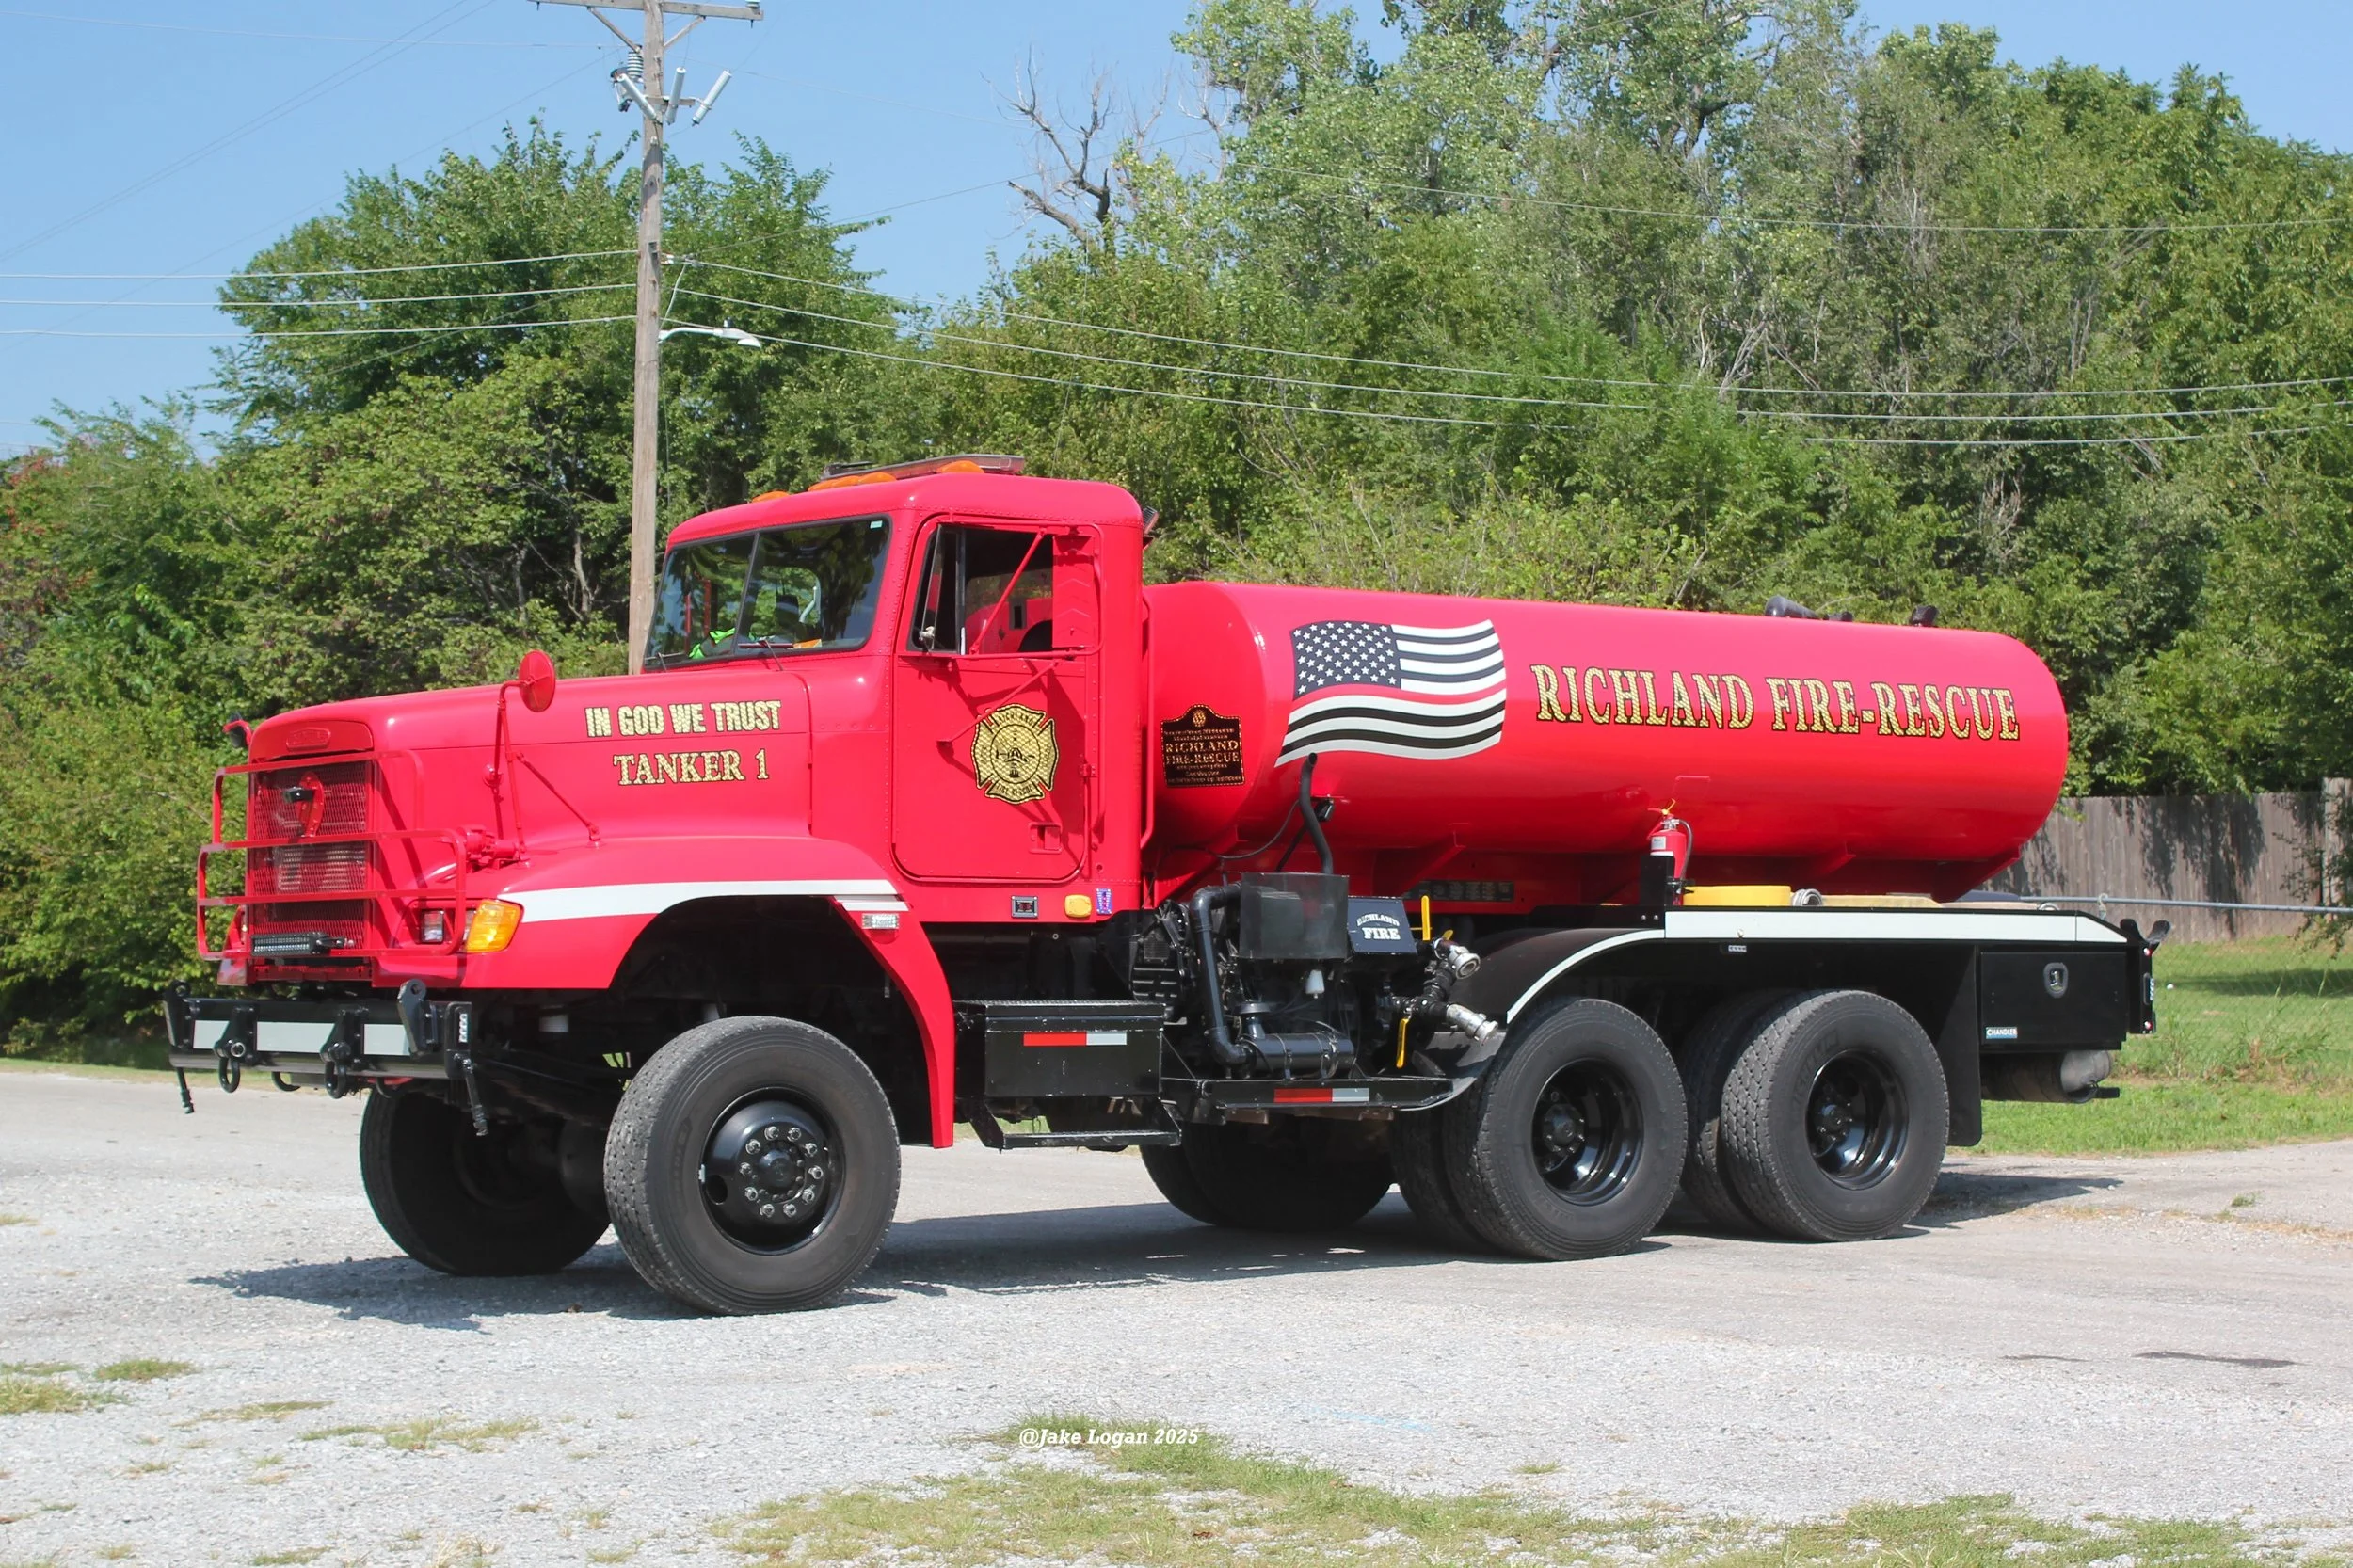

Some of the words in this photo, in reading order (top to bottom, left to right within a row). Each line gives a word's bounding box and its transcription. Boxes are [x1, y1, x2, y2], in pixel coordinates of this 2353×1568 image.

[1530, 664, 1754, 729] RICHLAND
[1766, 677, 2021, 741] FIRE-RESCUE
[584, 707, 612, 737] IN
[617, 705, 664, 736] GOD
[668, 703, 706, 734] WE
[710, 700, 781, 732] TRUST
[1165, 740, 1239, 753] RICHLAND
[613, 749, 745, 786] TANKER
[755, 748, 769, 780] 1
[1356, 913, 1401, 927] RICHLAND
[1362, 927, 1401, 940] FIRE
